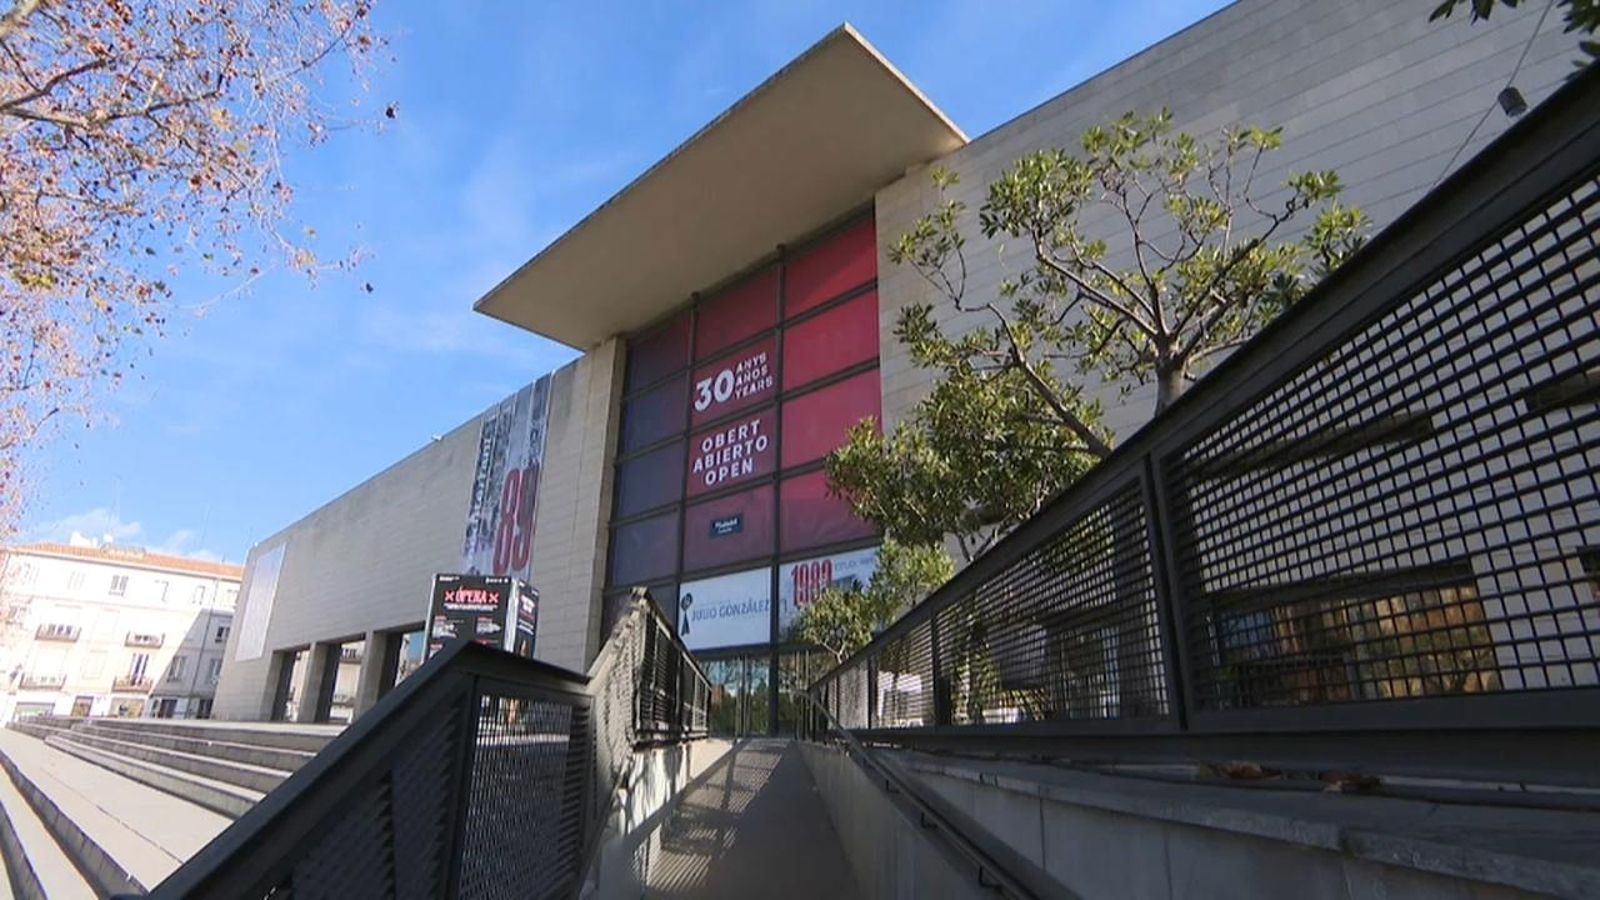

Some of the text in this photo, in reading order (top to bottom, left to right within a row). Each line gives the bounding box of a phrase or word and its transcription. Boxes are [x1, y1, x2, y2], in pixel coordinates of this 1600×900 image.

[735, 352, 767, 374] ANYS
[695, 369, 735, 411] 30
[734, 375, 773, 400] YEARS
[702, 419, 761, 453] OBERT
[693, 435, 769, 474] ABIERTO
[705, 458, 754, 485] OPEN
[692, 608, 718, 622] JULIO
